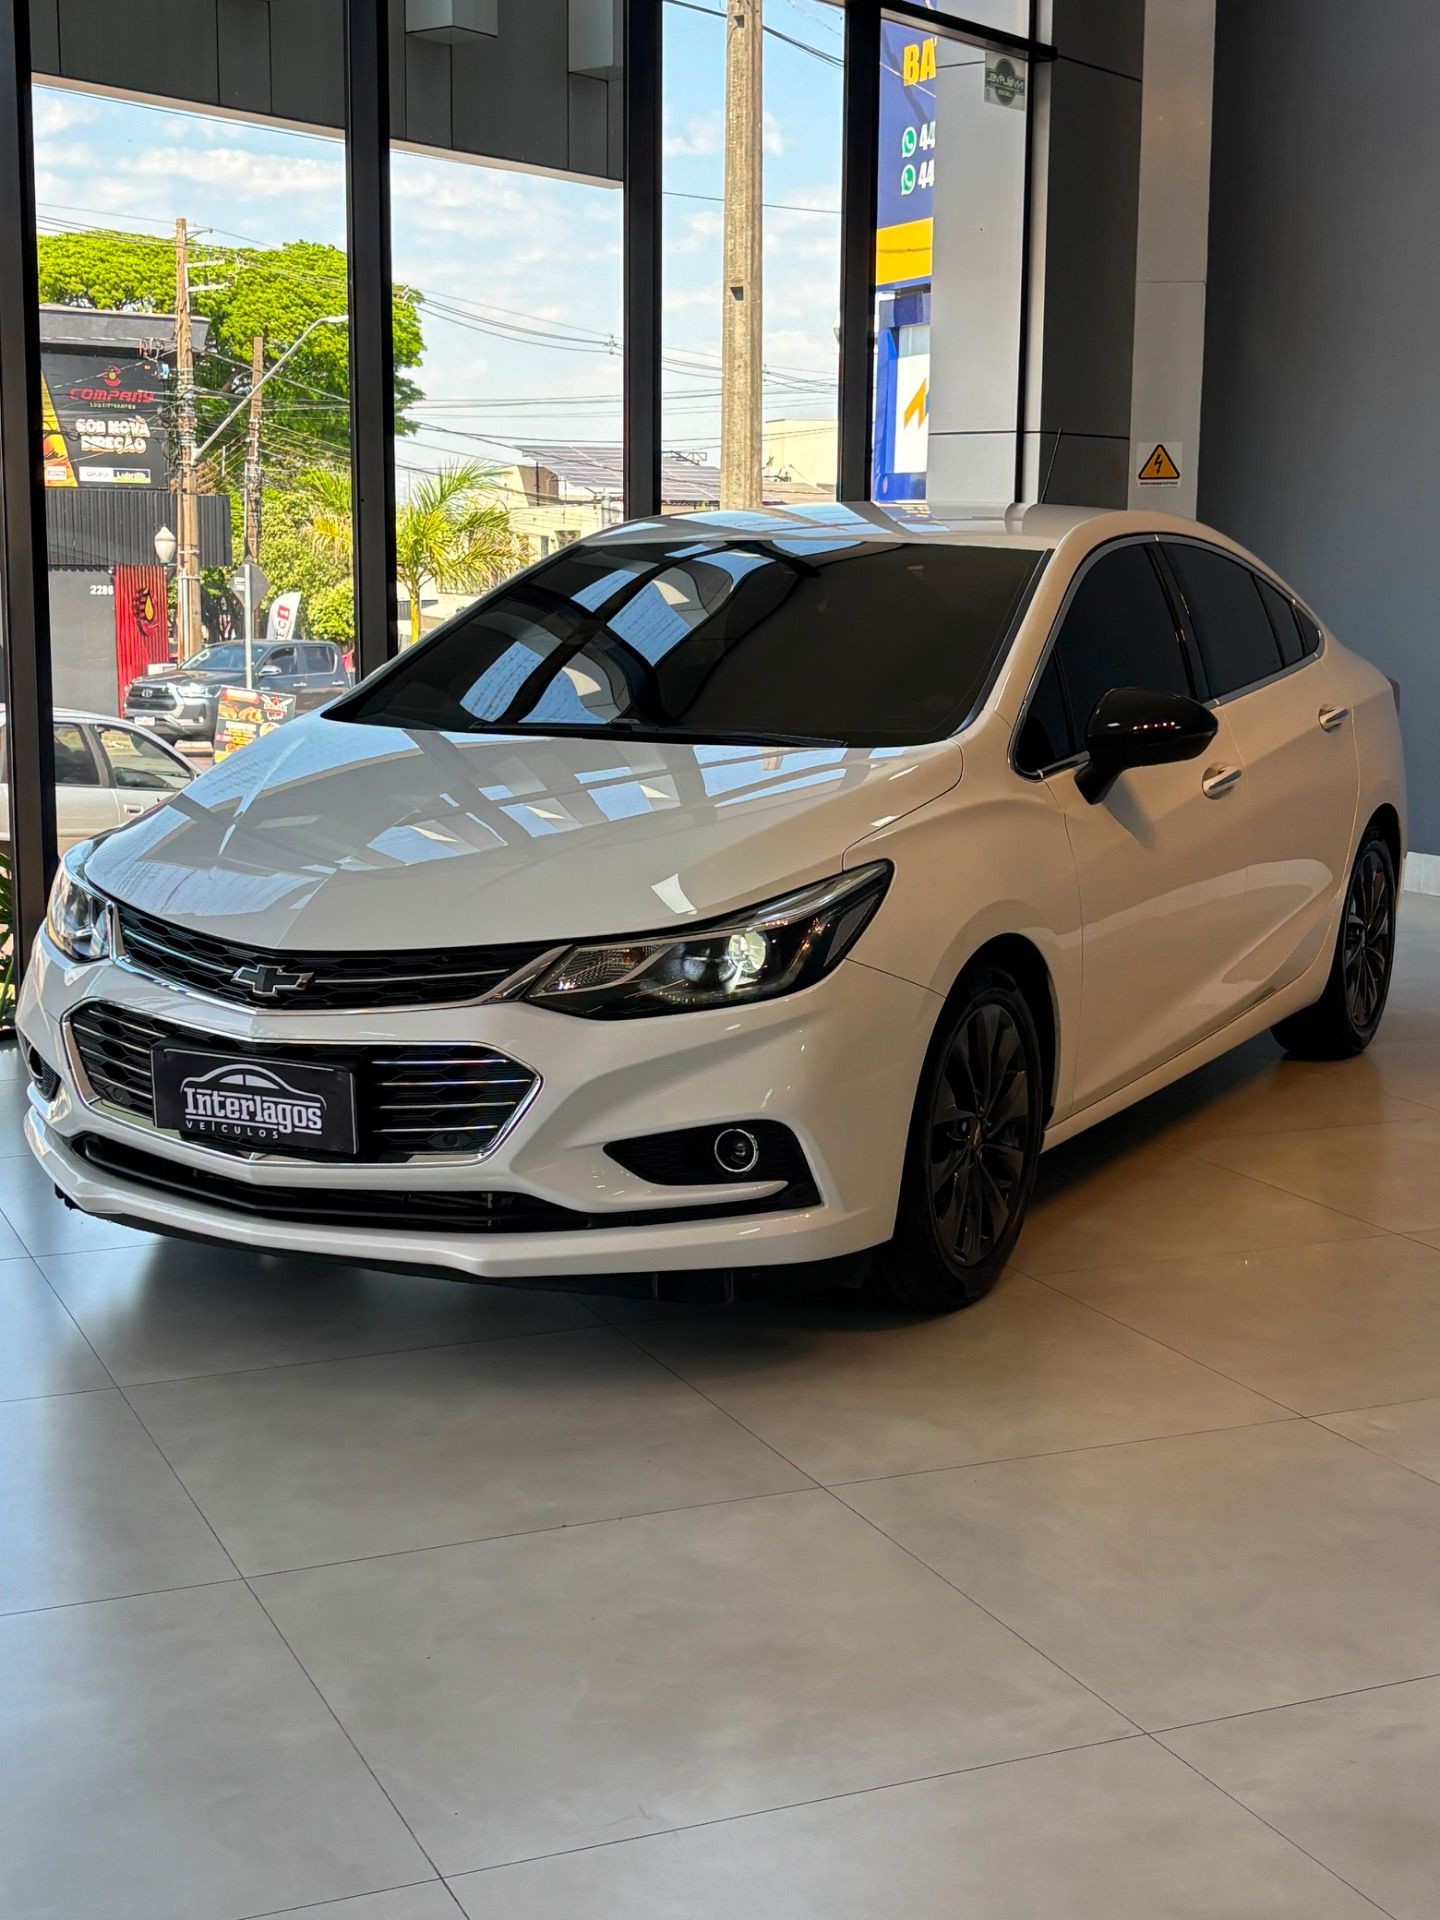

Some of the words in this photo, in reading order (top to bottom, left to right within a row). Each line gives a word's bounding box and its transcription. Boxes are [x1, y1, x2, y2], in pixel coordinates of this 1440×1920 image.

[903, 36, 938, 87] BA
[68, 388, 155, 403] COMPANY
[184, 1087, 322, 1134] Interlagos
[185, 1119, 279, 1140] VEÍCULOS
